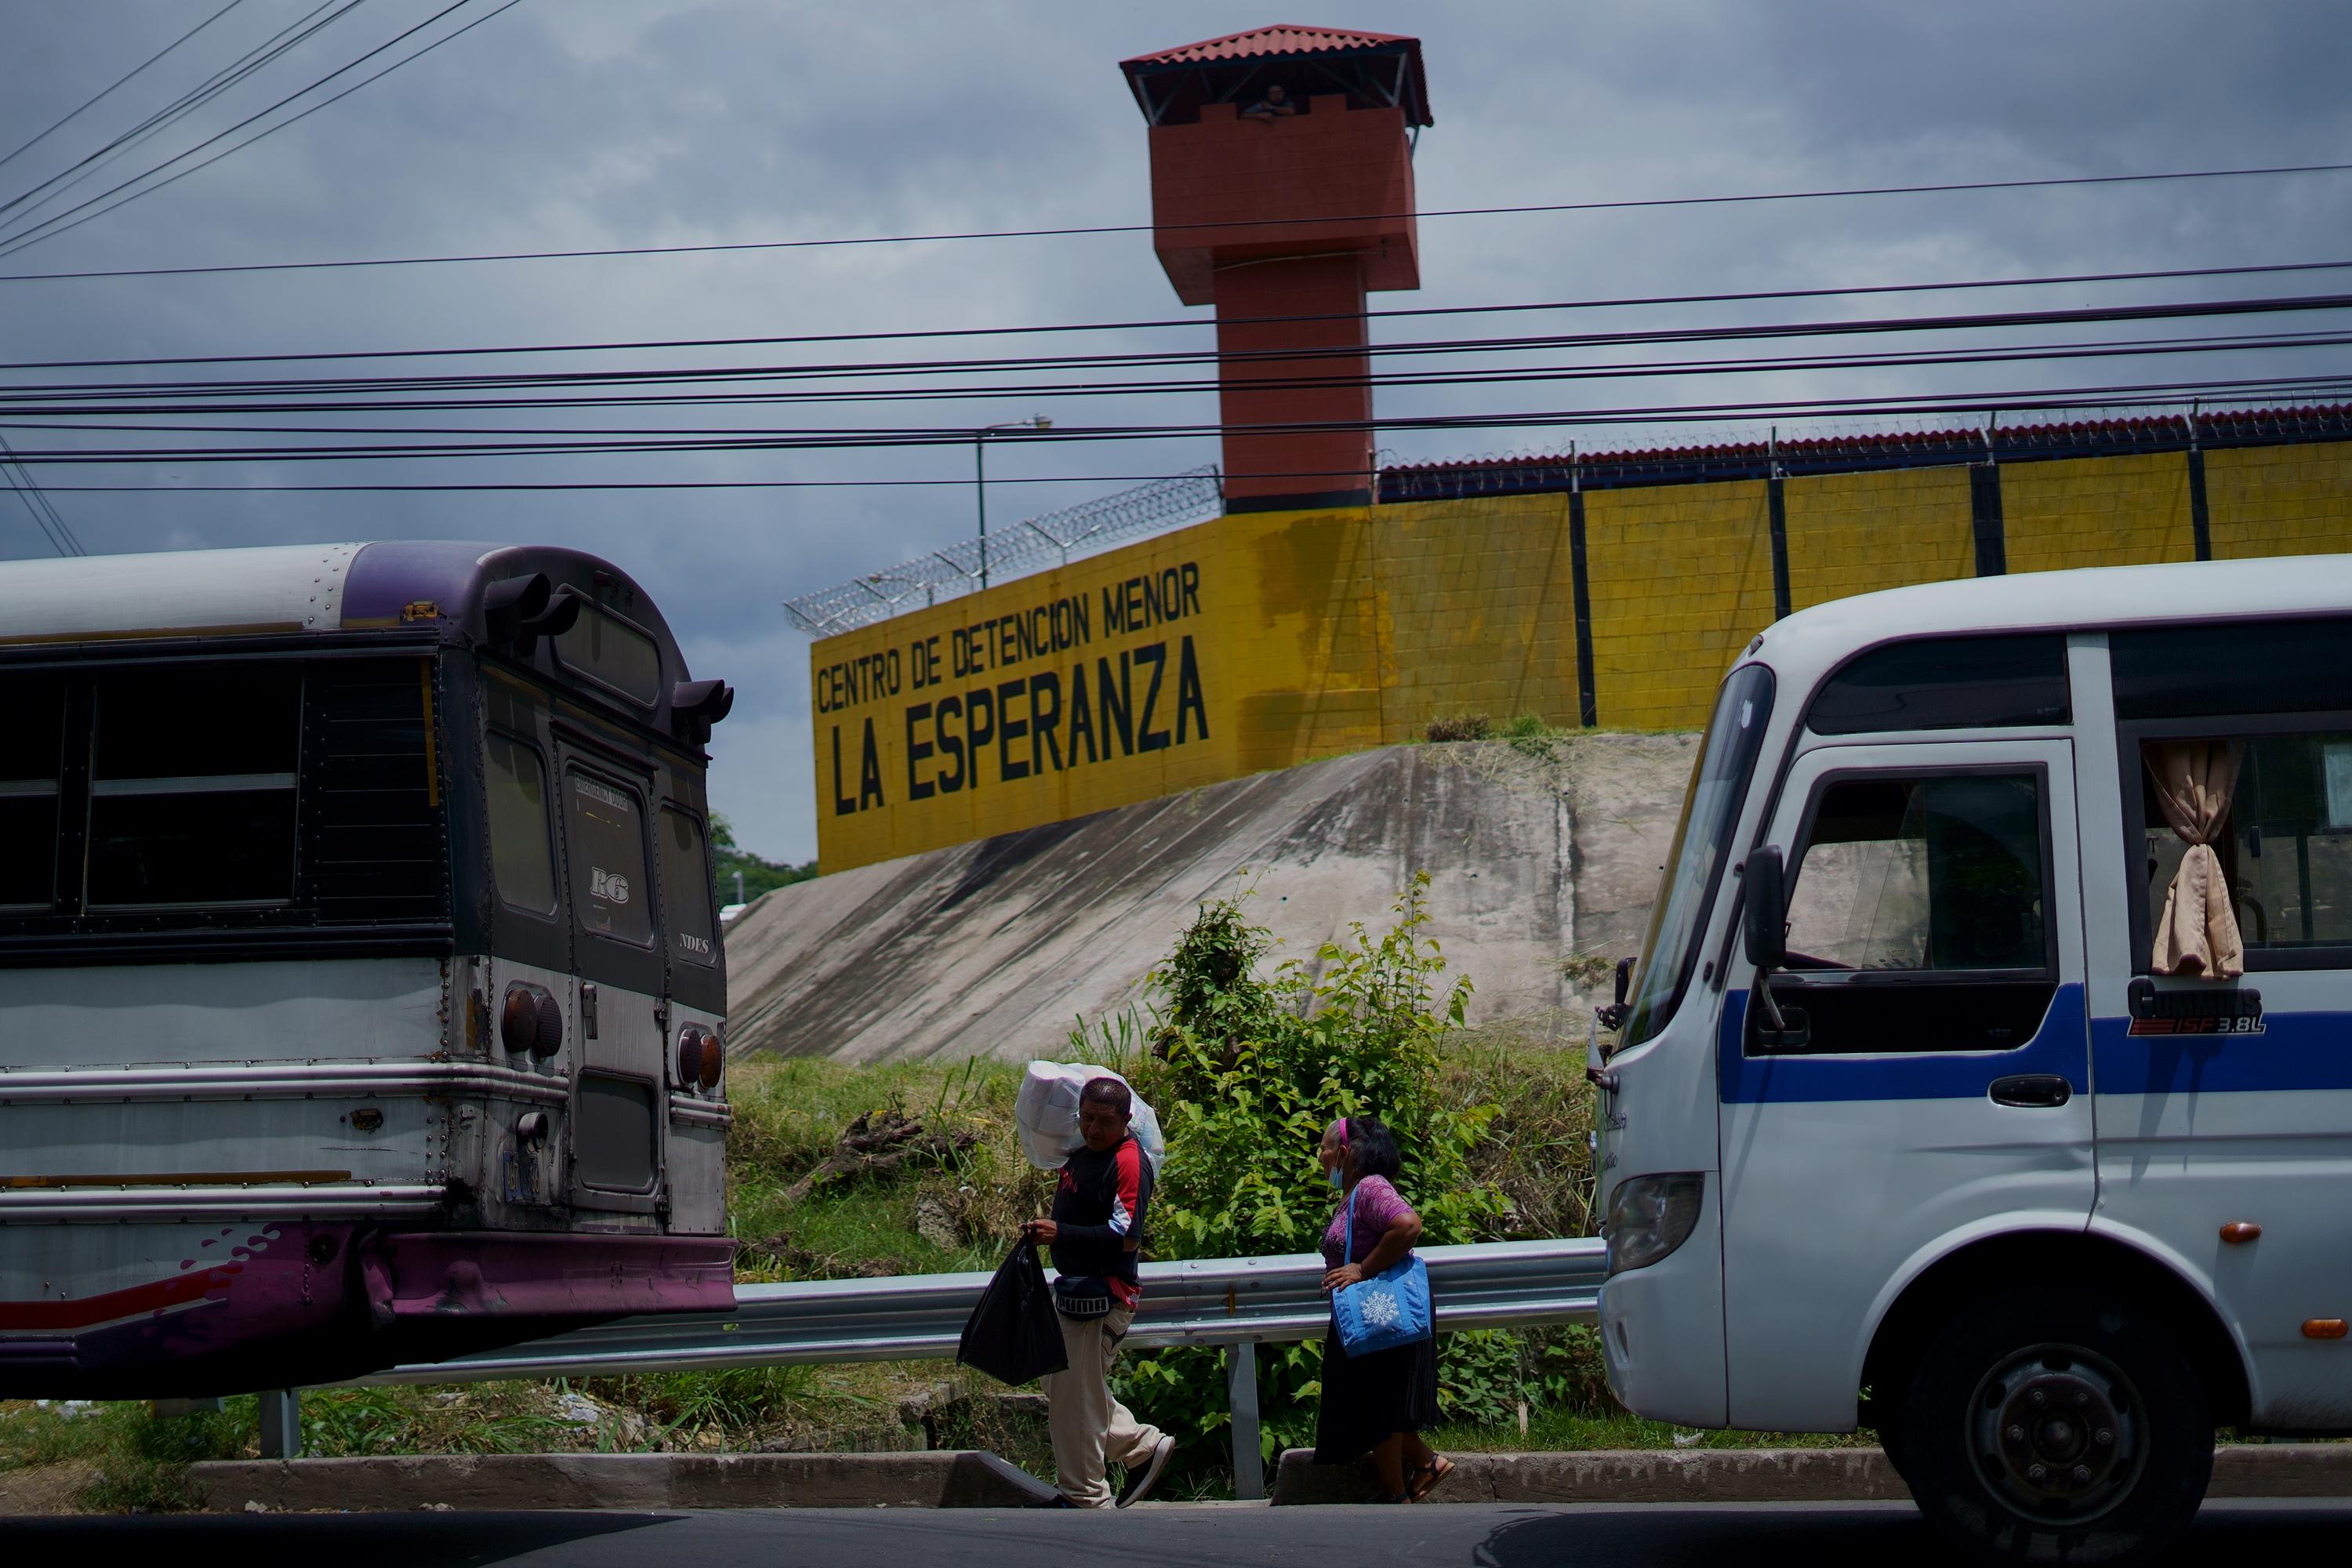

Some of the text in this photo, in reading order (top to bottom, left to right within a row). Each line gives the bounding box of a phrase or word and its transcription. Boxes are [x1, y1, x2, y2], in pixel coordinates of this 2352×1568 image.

[818, 562, 1200, 713] CENTRO DE DETENCION MENOR
[833, 636, 1209, 815] LA ESPERANZA
[576, 774, 628, 810] EMERGENCY DOOR
[590, 866, 629, 903] R6
[2128, 977, 2263, 1018] CUMMINS
[2176, 1016, 2262, 1033] ISF 3.8L
[1059, 1298, 1106, 1313] PUMA
